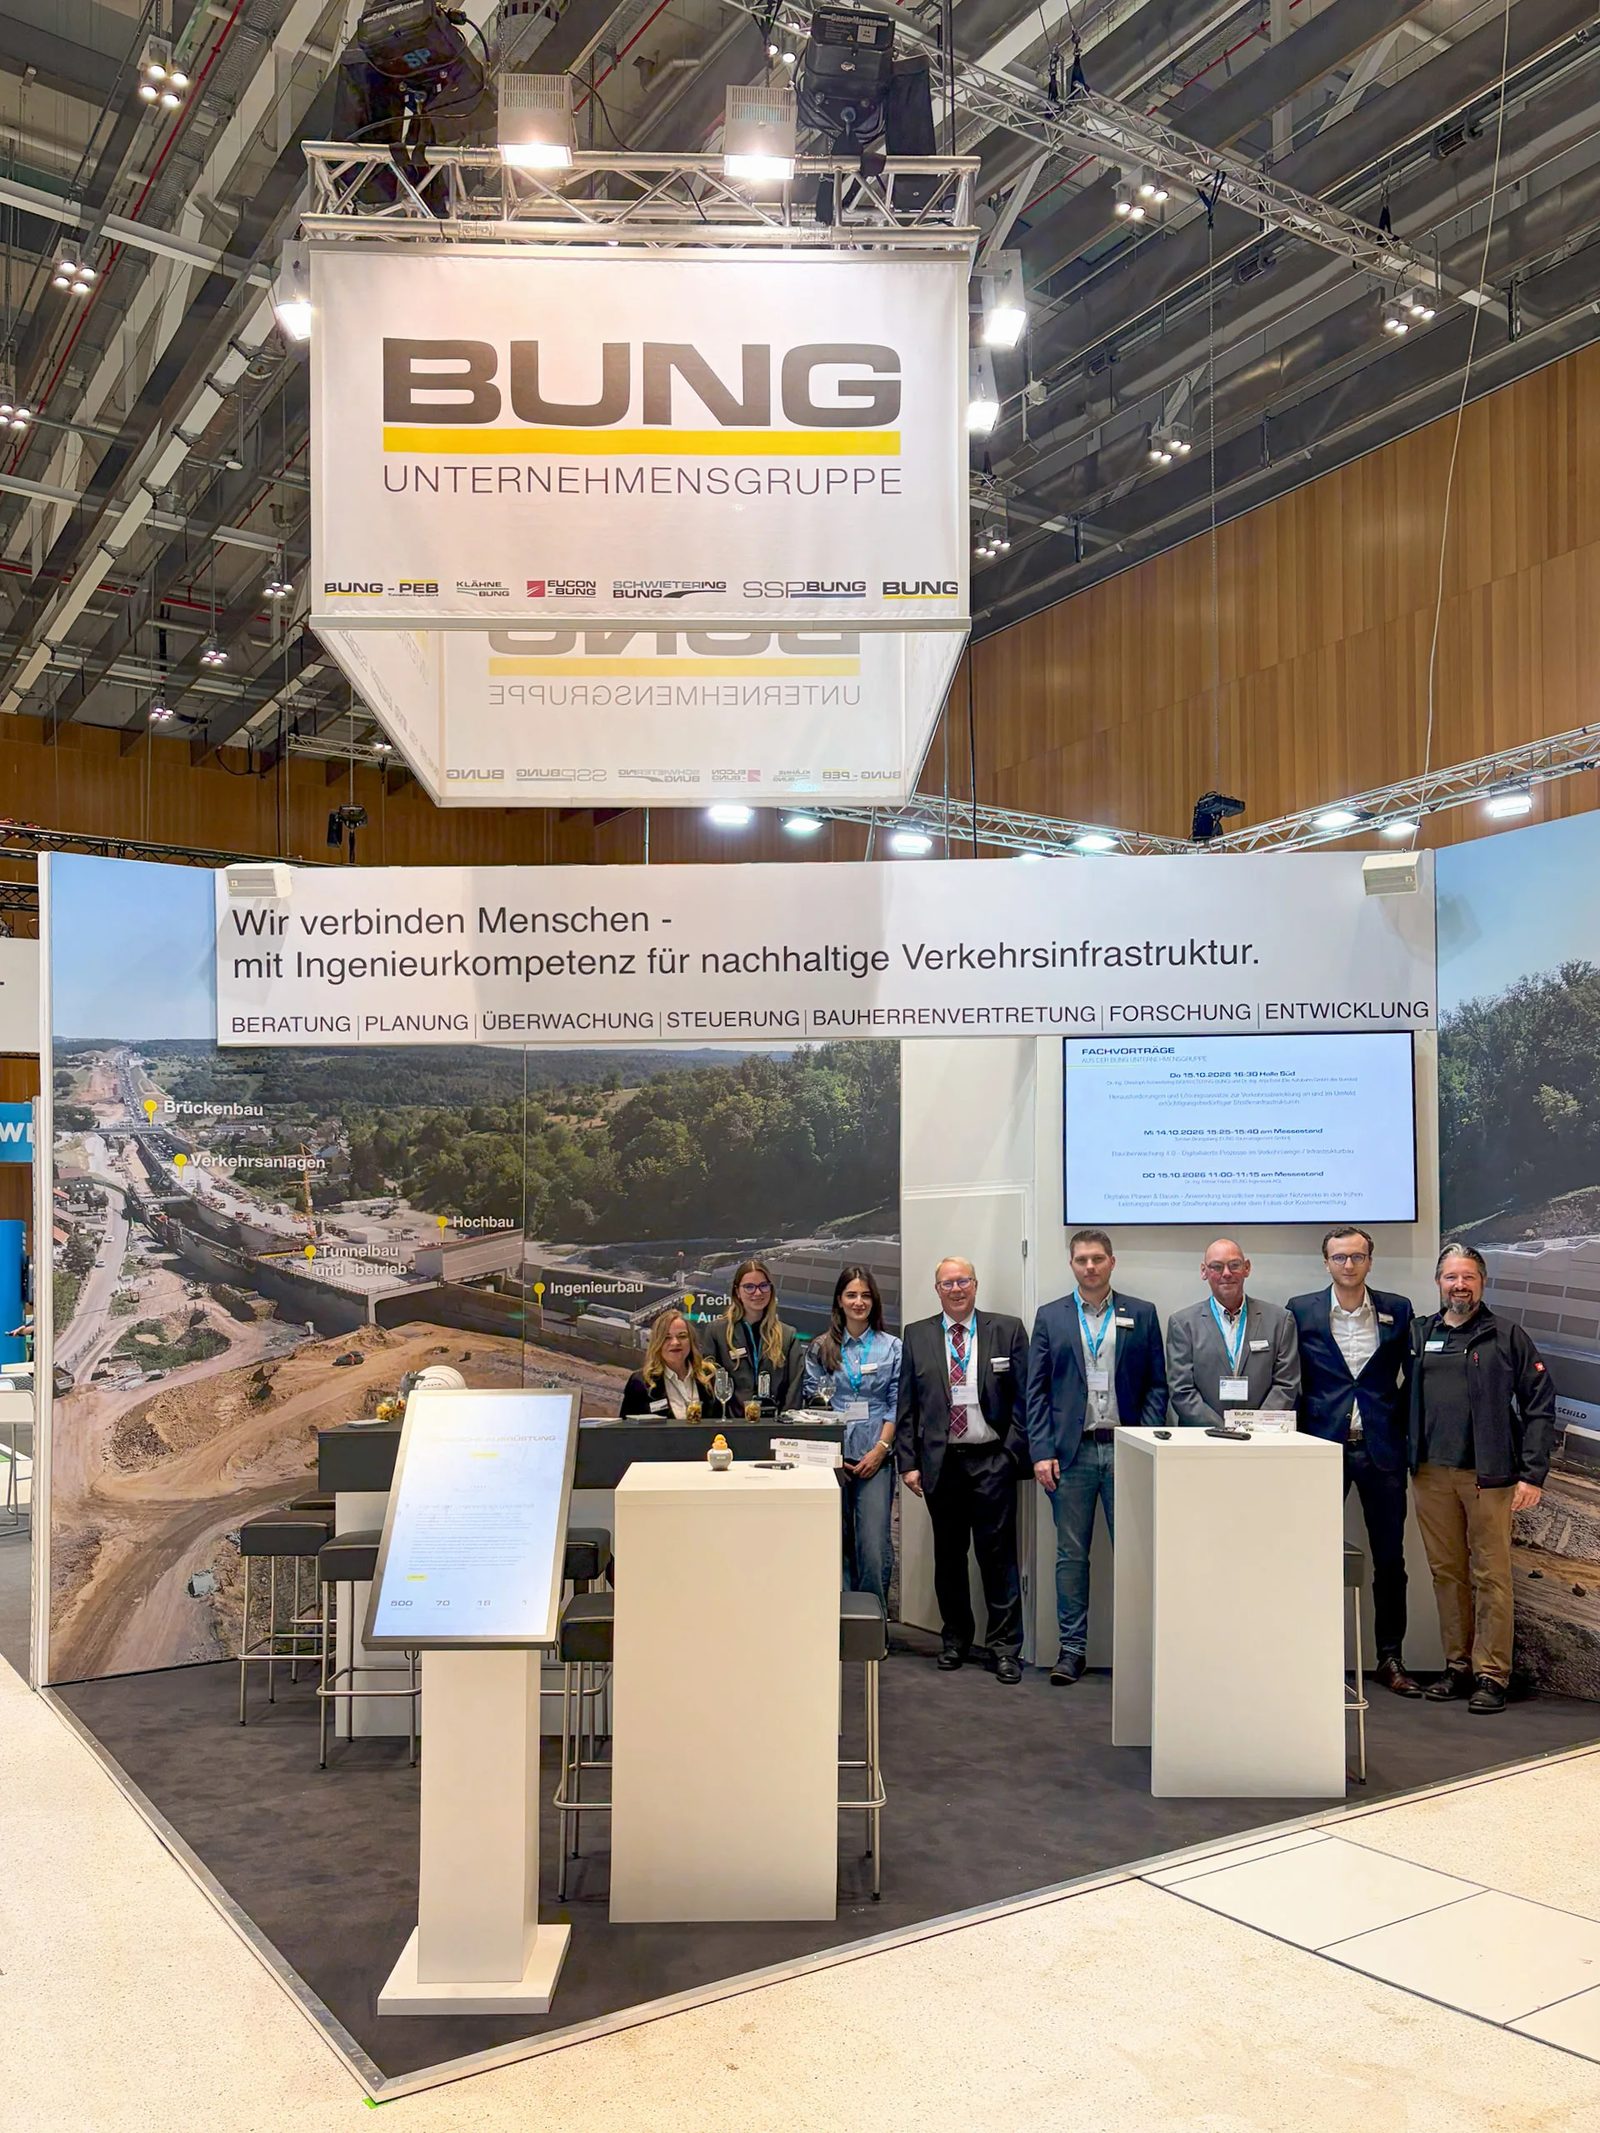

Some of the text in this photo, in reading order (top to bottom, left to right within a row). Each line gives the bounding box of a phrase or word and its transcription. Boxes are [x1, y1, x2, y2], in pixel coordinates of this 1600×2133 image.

[383, 338, 902, 427] BUNG
[384, 465, 902, 496] UNTERNEHMENSGRUPPE
[324, 582, 383, 594] BUNG
[399, 583, 439, 593] PEB
[456, 579, 502, 588] KLÄHNE
[547, 579, 596, 588] EUCON
[612, 580, 727, 589] SCHWIETERING
[882, 581, 959, 595] BUNG
[612, 589, 663, 599] BUNG
[232, 909, 289, 936] Wir
[300, 908, 464, 936] verbinden
[479, 906, 650, 934] Menschen
[234, 938, 1260, 986] mit Ingenieurkompetenz für nachhaltige Verkehrsinfrastruktur.
[231, 1000, 1430, 1034] BERATUNG PLANUNG ÜBERWACHUNG STEUERUNG BAUHERRENVERTRETUNG FORSCHUNG ENTWICKLUNG
[1081, 1045, 1175, 1055] FACHVORTRÄGE
[163, 1100, 264, 1117] Brückenbau
[190, 1153, 326, 1171] Verkehrsanlagen
[453, 1214, 514, 1229] Hochbau
[320, 1244, 399, 1257] Tunnelbau
[315, 1263, 344, 1277] und
[551, 1279, 644, 1296] Ingenieurbau
